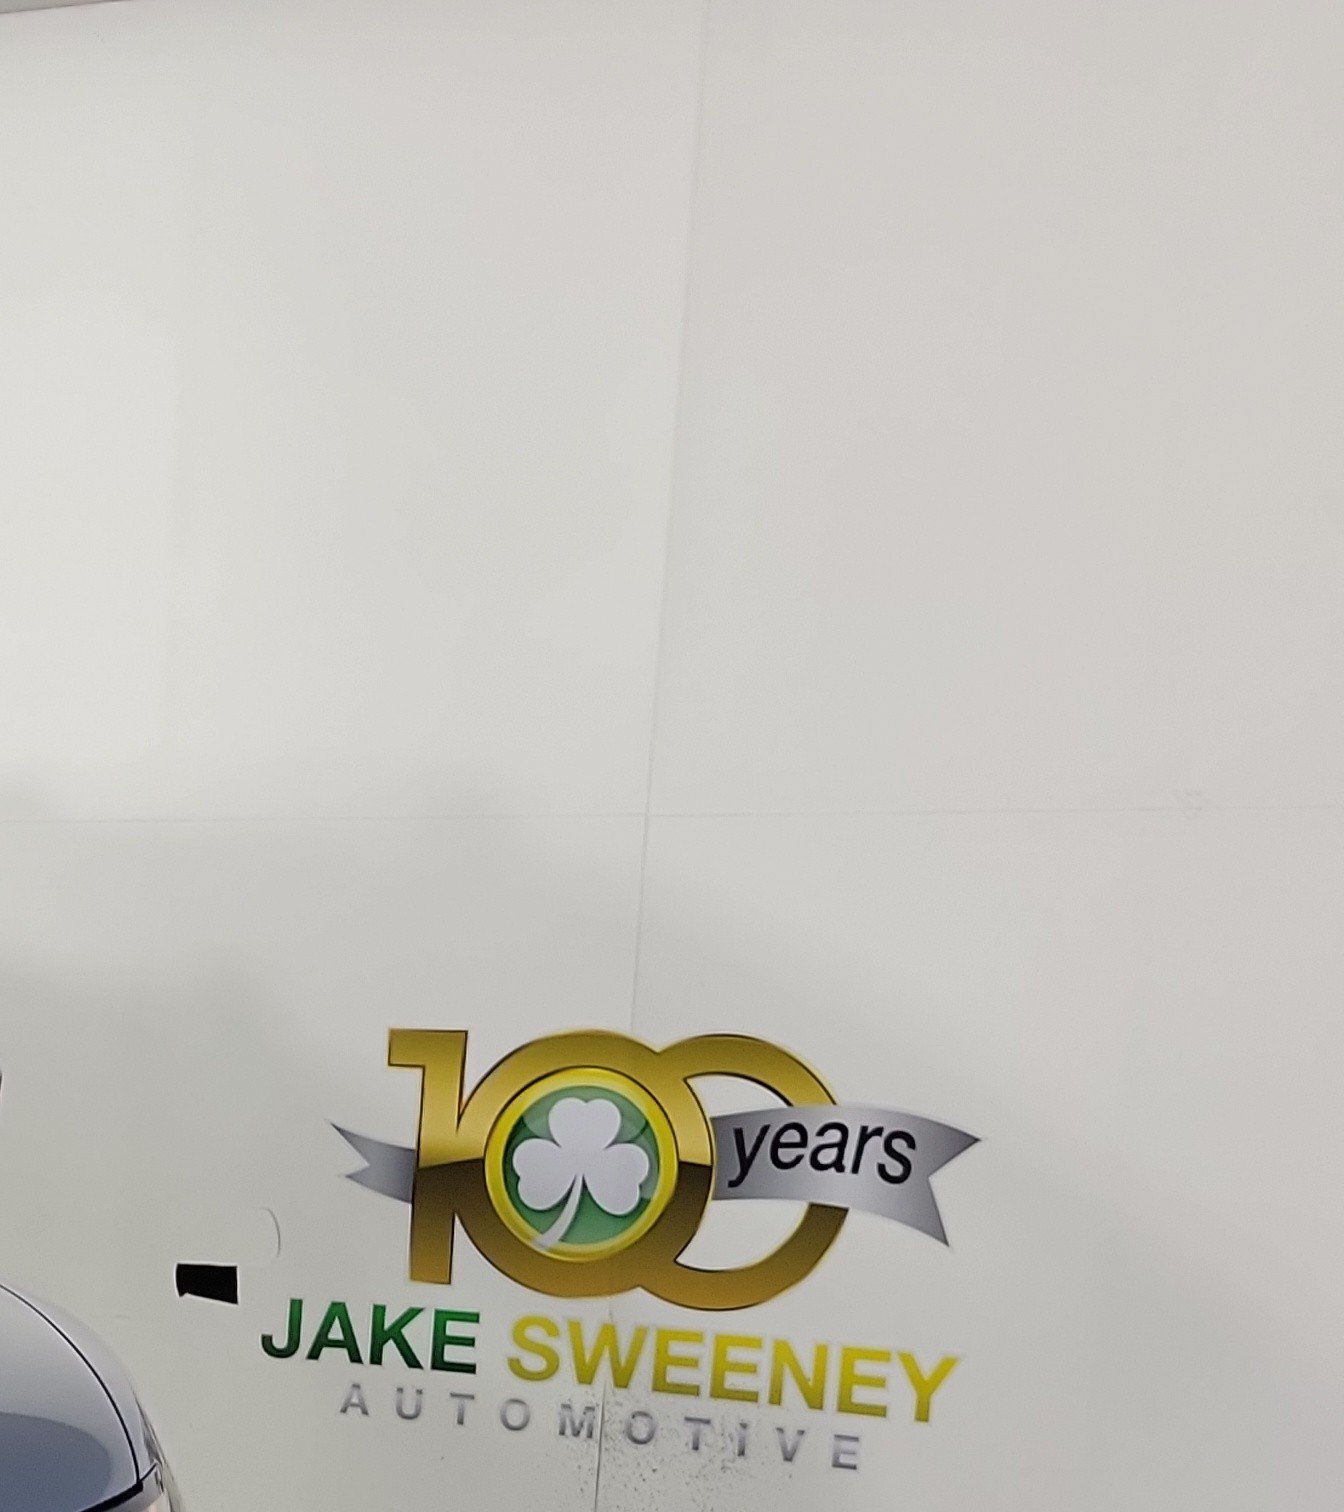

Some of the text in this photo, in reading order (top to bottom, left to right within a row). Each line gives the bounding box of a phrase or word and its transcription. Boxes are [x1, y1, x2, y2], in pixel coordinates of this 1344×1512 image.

[387, 1028, 917, 1311] 100 years
[260, 1297, 959, 1423] JAKE SWEENEY
[339, 1383, 860, 1471] AUTOMOTIVE
